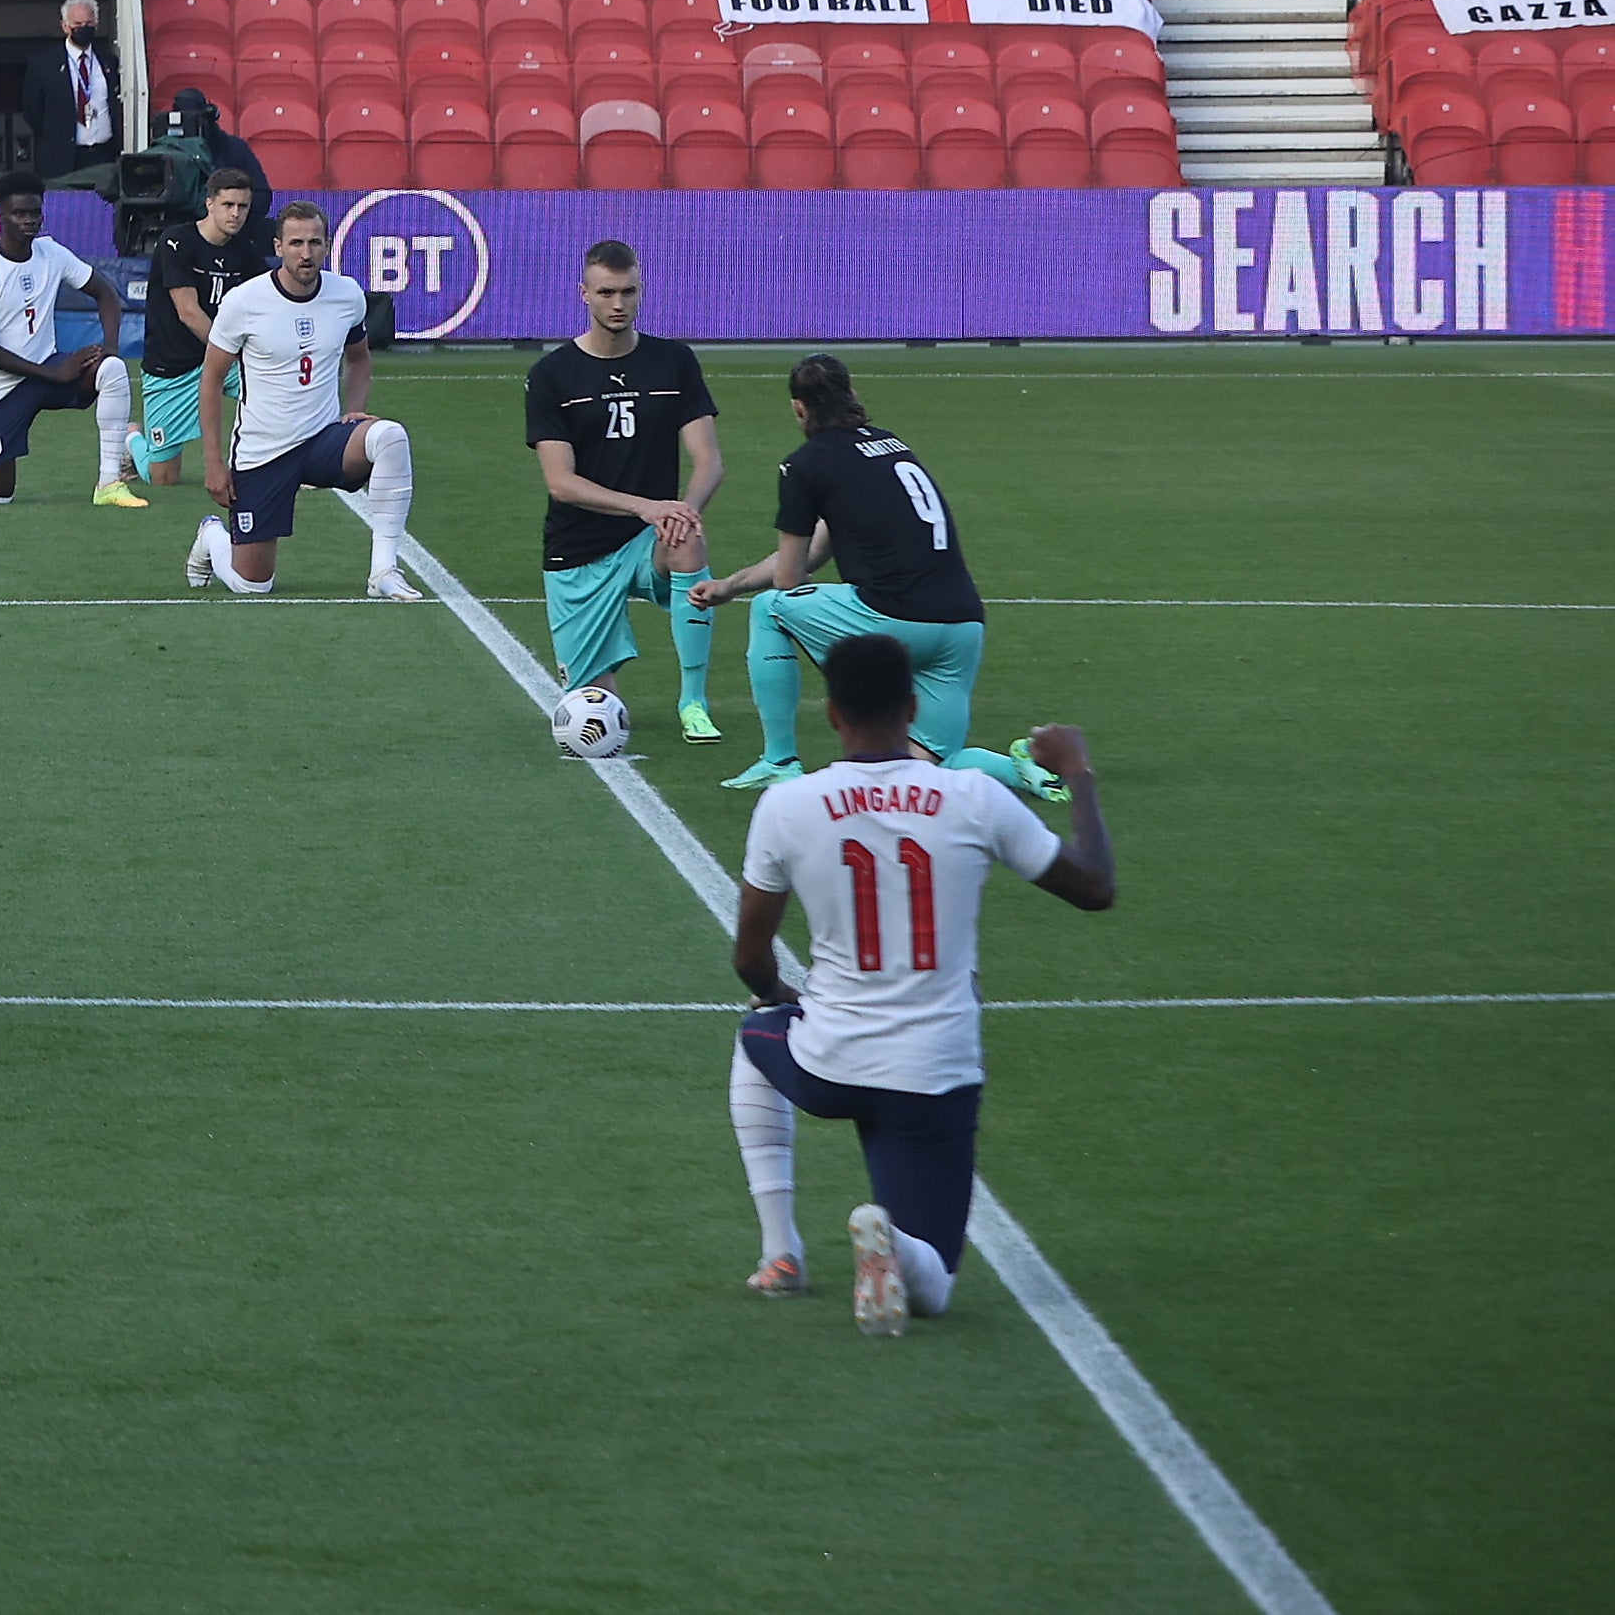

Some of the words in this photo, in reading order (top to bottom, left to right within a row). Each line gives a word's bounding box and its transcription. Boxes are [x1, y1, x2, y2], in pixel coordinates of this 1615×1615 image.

[1467, 0, 1609, 24] GAZZA
[370, 236, 454, 293] BT
[1149, 190, 1507, 331] SEARCH
[24, 308, 36, 335] 7
[299, 356, 313, 386] 9
[605, 400, 636, 439] 25
[893, 461, 948, 550] 9
[822, 785, 945, 821] LINGARD
[841, 836, 937, 971] 11
